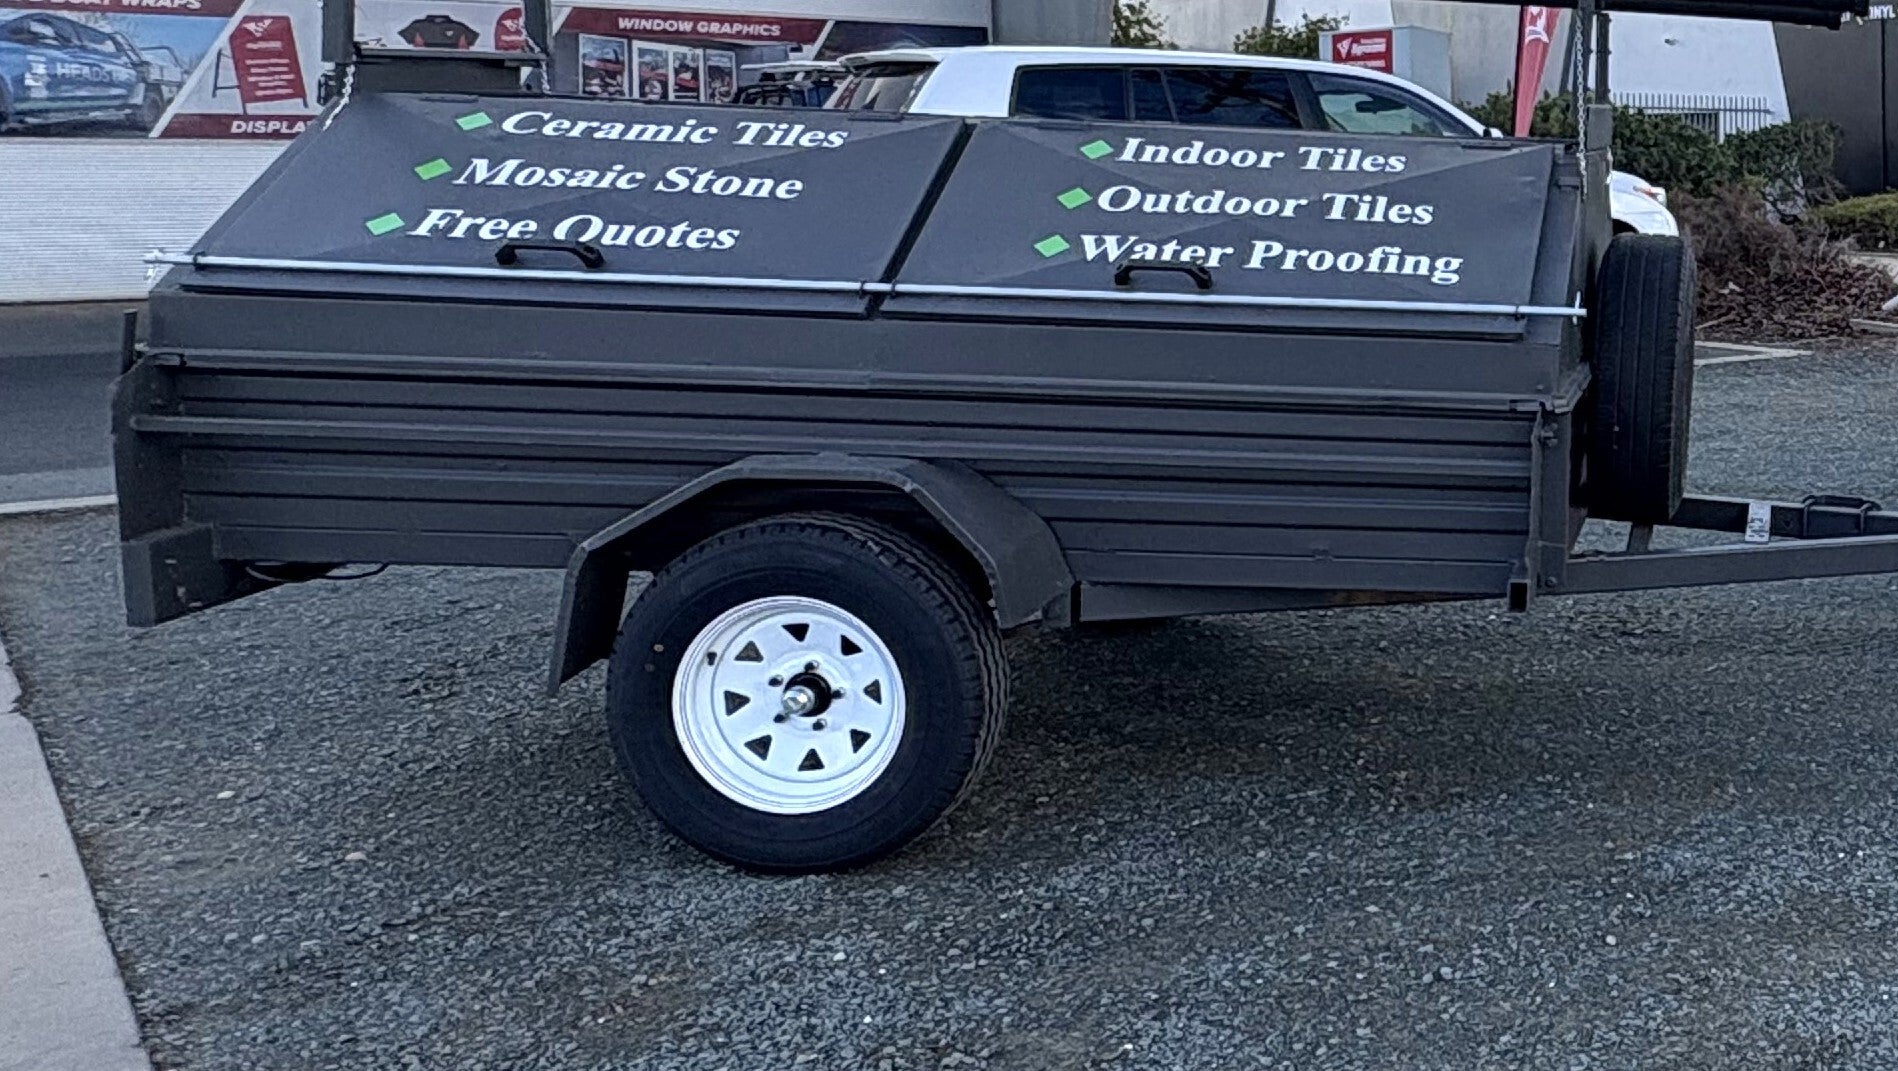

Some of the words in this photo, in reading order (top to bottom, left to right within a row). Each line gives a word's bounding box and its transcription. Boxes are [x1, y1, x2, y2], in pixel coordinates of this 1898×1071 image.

[618, 16, 694, 34] WINDOW
[697, 19, 782, 38] GRAPHICS
[231, 120, 311, 134] DISPLA
[501, 110, 719, 146] Ceramic
[735, 120, 850, 150] Tiles
[1115, 136, 1285, 169] Indoor
[1299, 145, 1407, 174] Tiles
[452, 157, 646, 192] Mosaic
[654, 164, 805, 201] Stone
[1097, 185, 1309, 219] Outdoor
[1322, 192, 1435, 226] Tiles
[407, 208, 538, 242] Free
[553, 213, 741, 251] Quotes
[1080, 233, 1235, 269] Water
[1242, 239, 1464, 286] Proofing
